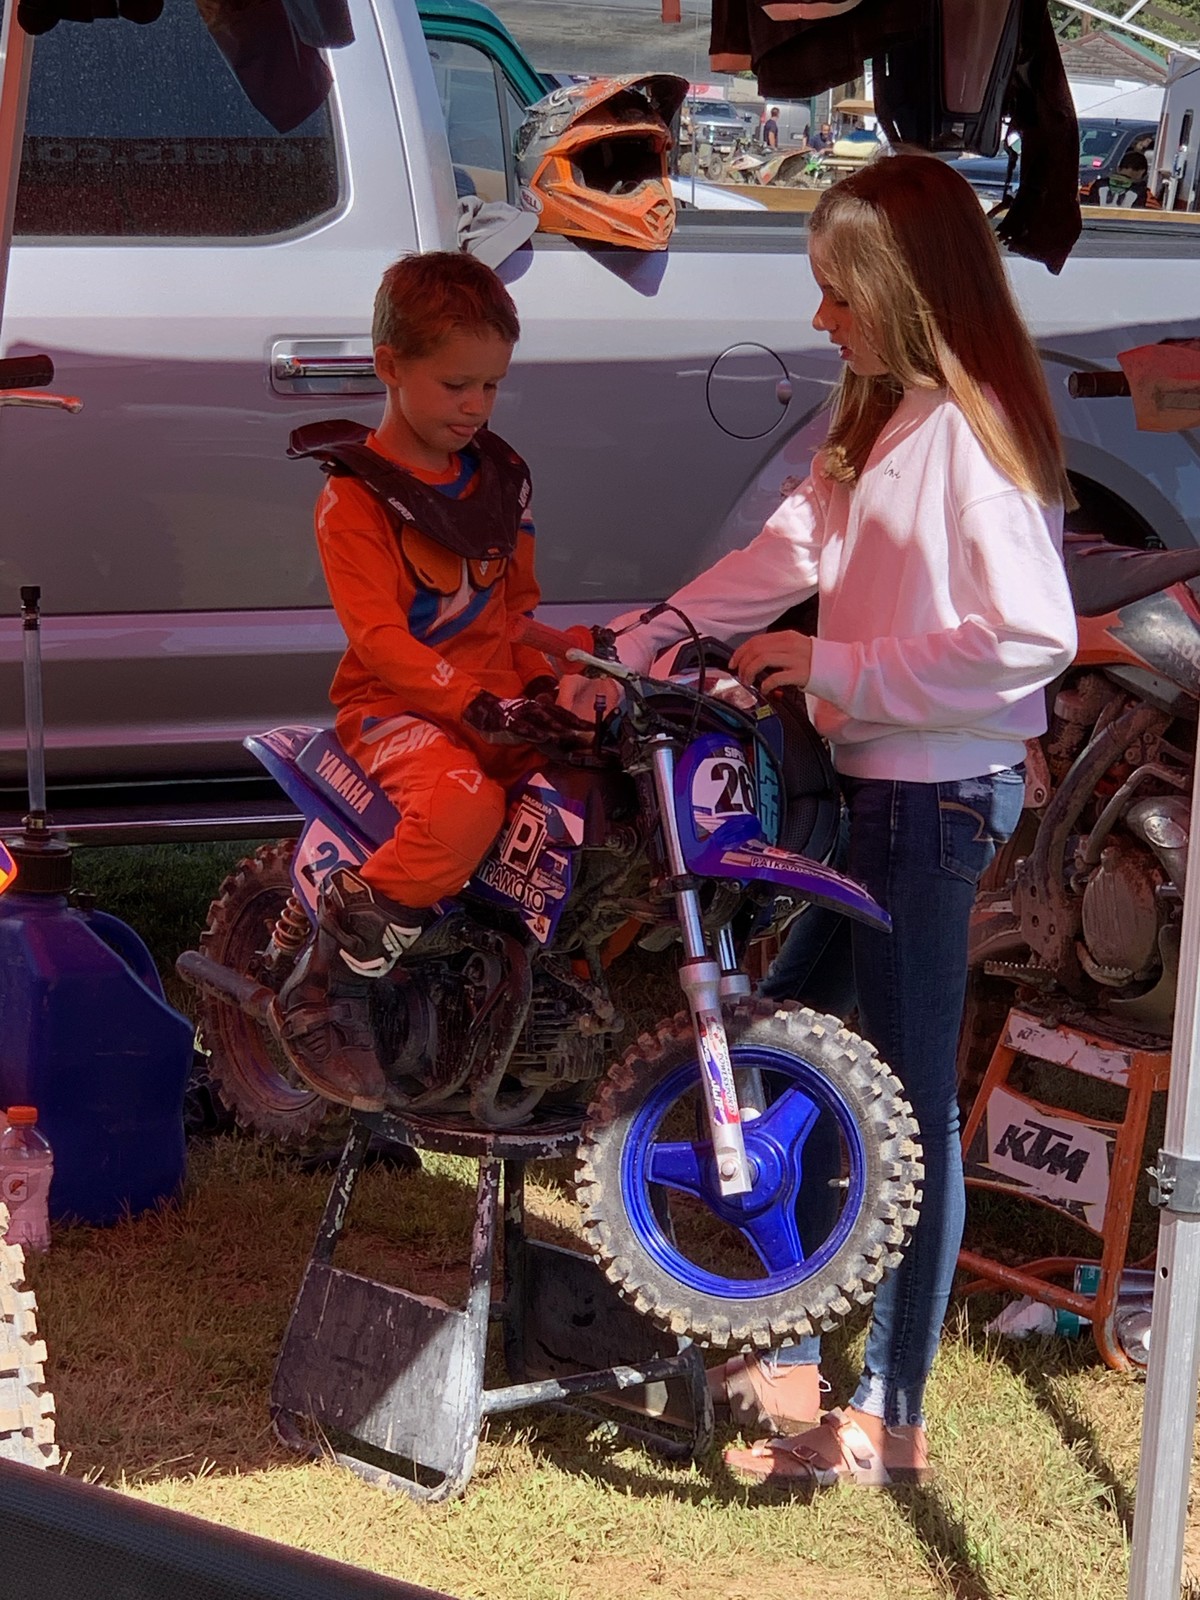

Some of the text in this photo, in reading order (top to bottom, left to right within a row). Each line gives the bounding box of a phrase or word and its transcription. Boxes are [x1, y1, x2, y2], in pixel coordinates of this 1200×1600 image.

[315, 749, 375, 815] YAMAHA
[522, 793, 552, 816] MAGNUM
[301, 841, 352, 890] 2
[993, 1119, 1090, 1184] KTM
